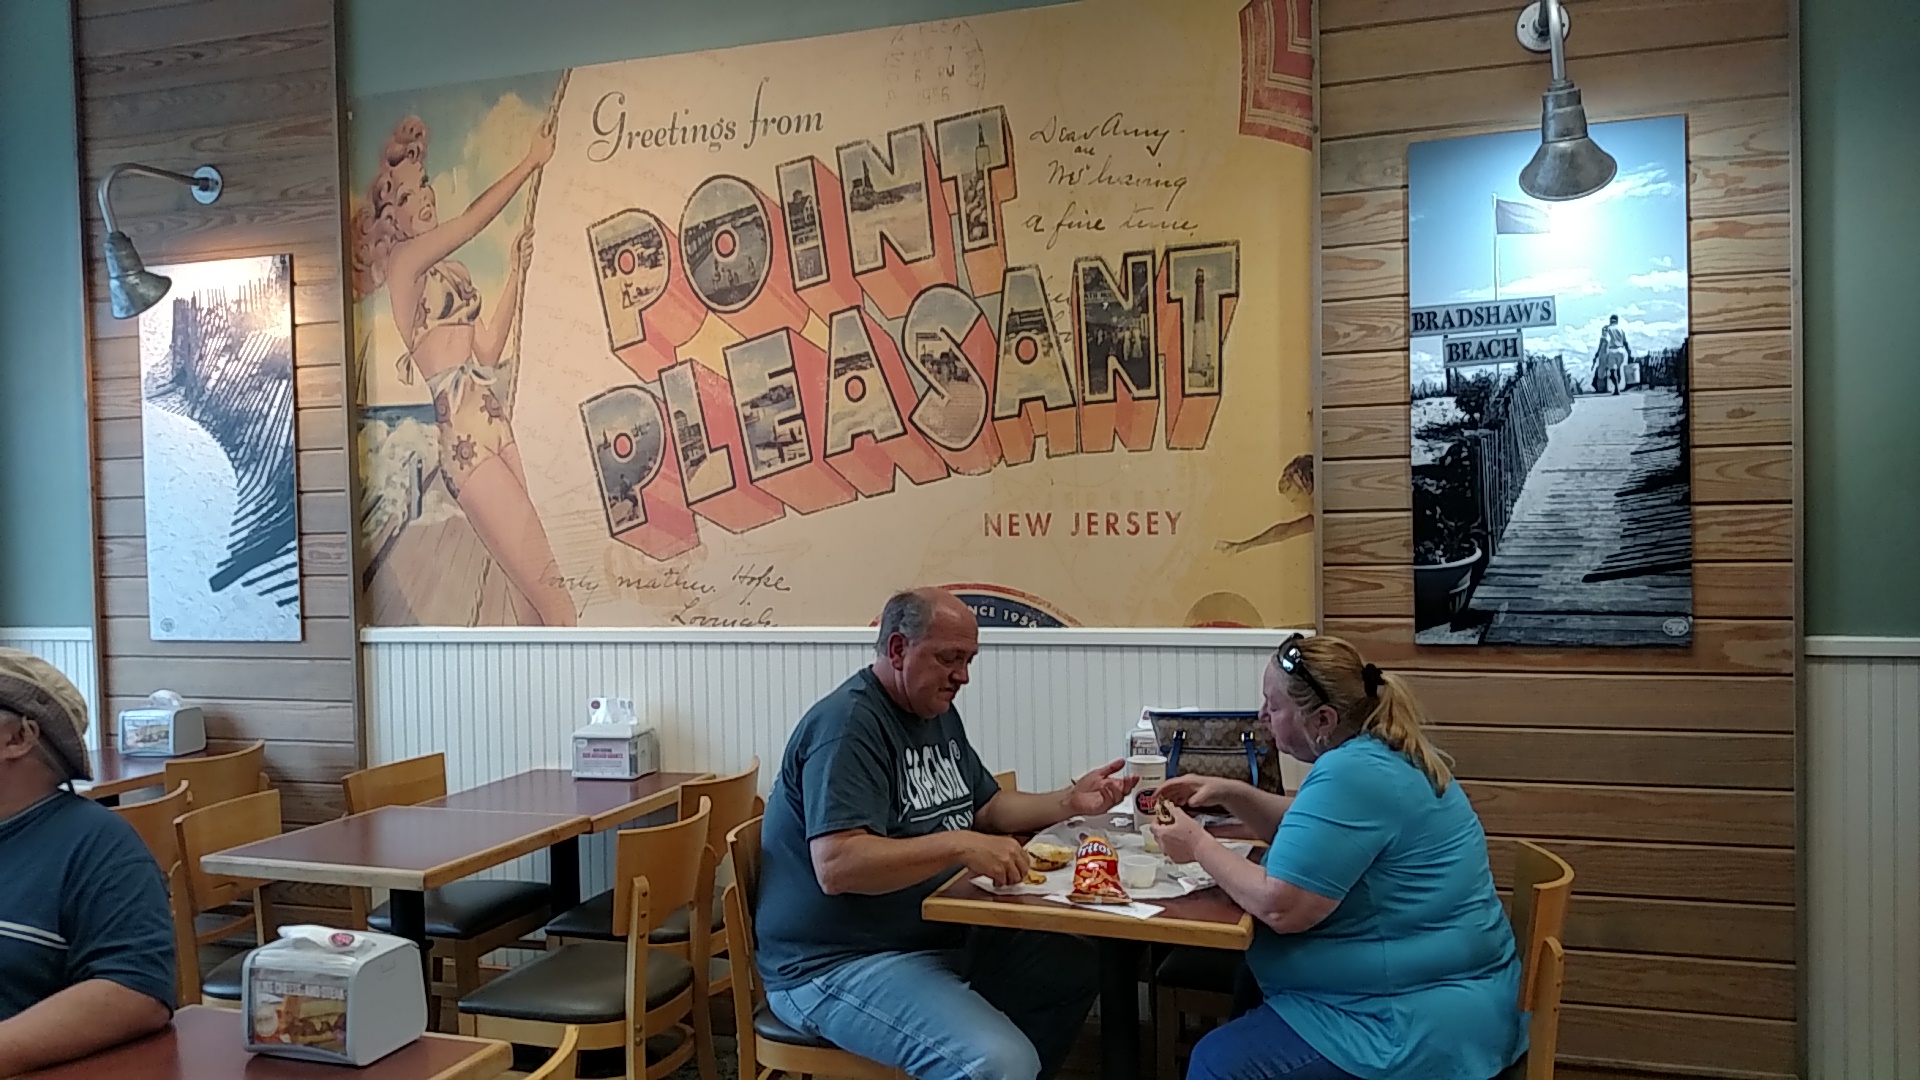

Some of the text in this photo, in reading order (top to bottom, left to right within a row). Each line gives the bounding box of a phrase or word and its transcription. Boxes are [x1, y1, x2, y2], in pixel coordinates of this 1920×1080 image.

[587, 76, 825, 163] Greetings from
[1029, 115, 1099, 144] Dear
[585, 103, 1011, 354] POINT
[1023, 213, 1045, 232] a
[1046, 201, 1106, 250] fine
[1411, 300, 1552, 332] BRADSHAW'S
[1445, 337, 1519, 363] BEACH
[578, 240, 1241, 540] PLEASANT
[983, 510, 1183, 537] NEW JERSEY
[967, 604, 996, 618] NCE
